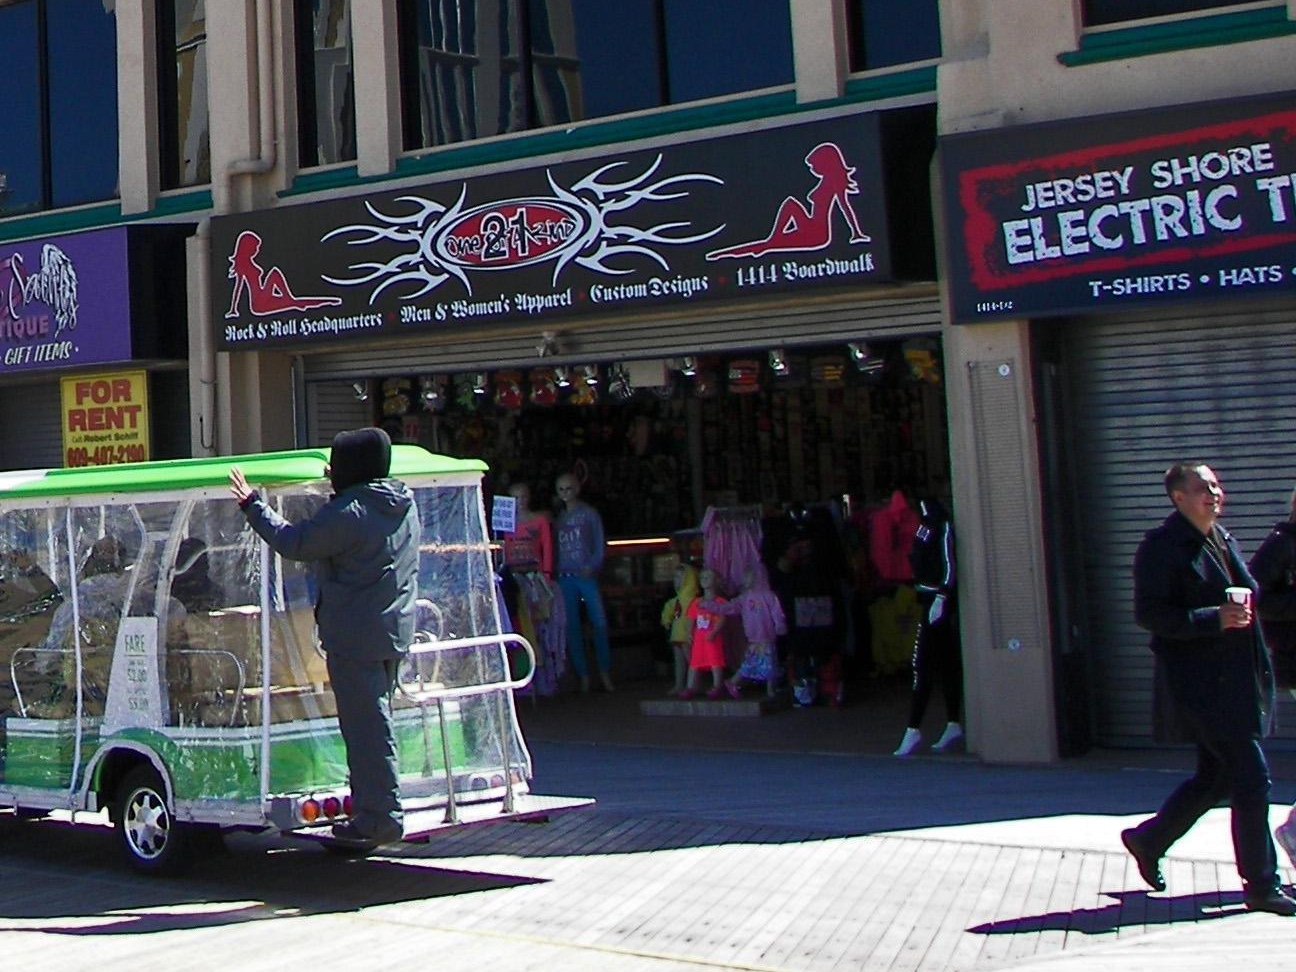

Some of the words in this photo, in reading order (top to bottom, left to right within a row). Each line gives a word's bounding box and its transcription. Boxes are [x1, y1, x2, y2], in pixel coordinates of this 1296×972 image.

[1020, 166, 1134, 211] JERSEY
[1150, 143, 1275, 188] SHORE
[1002, 184, 1243, 265] ELECTRIC
[1256, 173, 1296, 223] T
[736, 264, 777, 287] 1414
[782, 252, 875, 280] Boardwalk
[1089, 272, 1191, 297] T-SHIRTS
[1219, 265, 1283, 286] HATS
[589, 284, 647, 303] Custom
[647, 275, 709, 298] Designs
[400, 304, 431, 323] Men
[435, 303, 448, 322] &
[451, 293, 510, 318] Women's
[514, 287, 572, 314] Apparel
[225, 325, 253, 341] Rock
[256, 323, 268, 339] &
[271, 319, 296, 336] Roll
[299, 312, 382, 336] Headquarters
[4, 346, 31, 365] GIFT
[34, 341, 72, 362] ITEMS
[75, 379, 132, 405] FOR
[68, 404, 142, 432] RENT
[84, 433, 112, 442] Robert
[114, 432, 139, 441] Schiff
[125, 634, 146, 653] FARE
